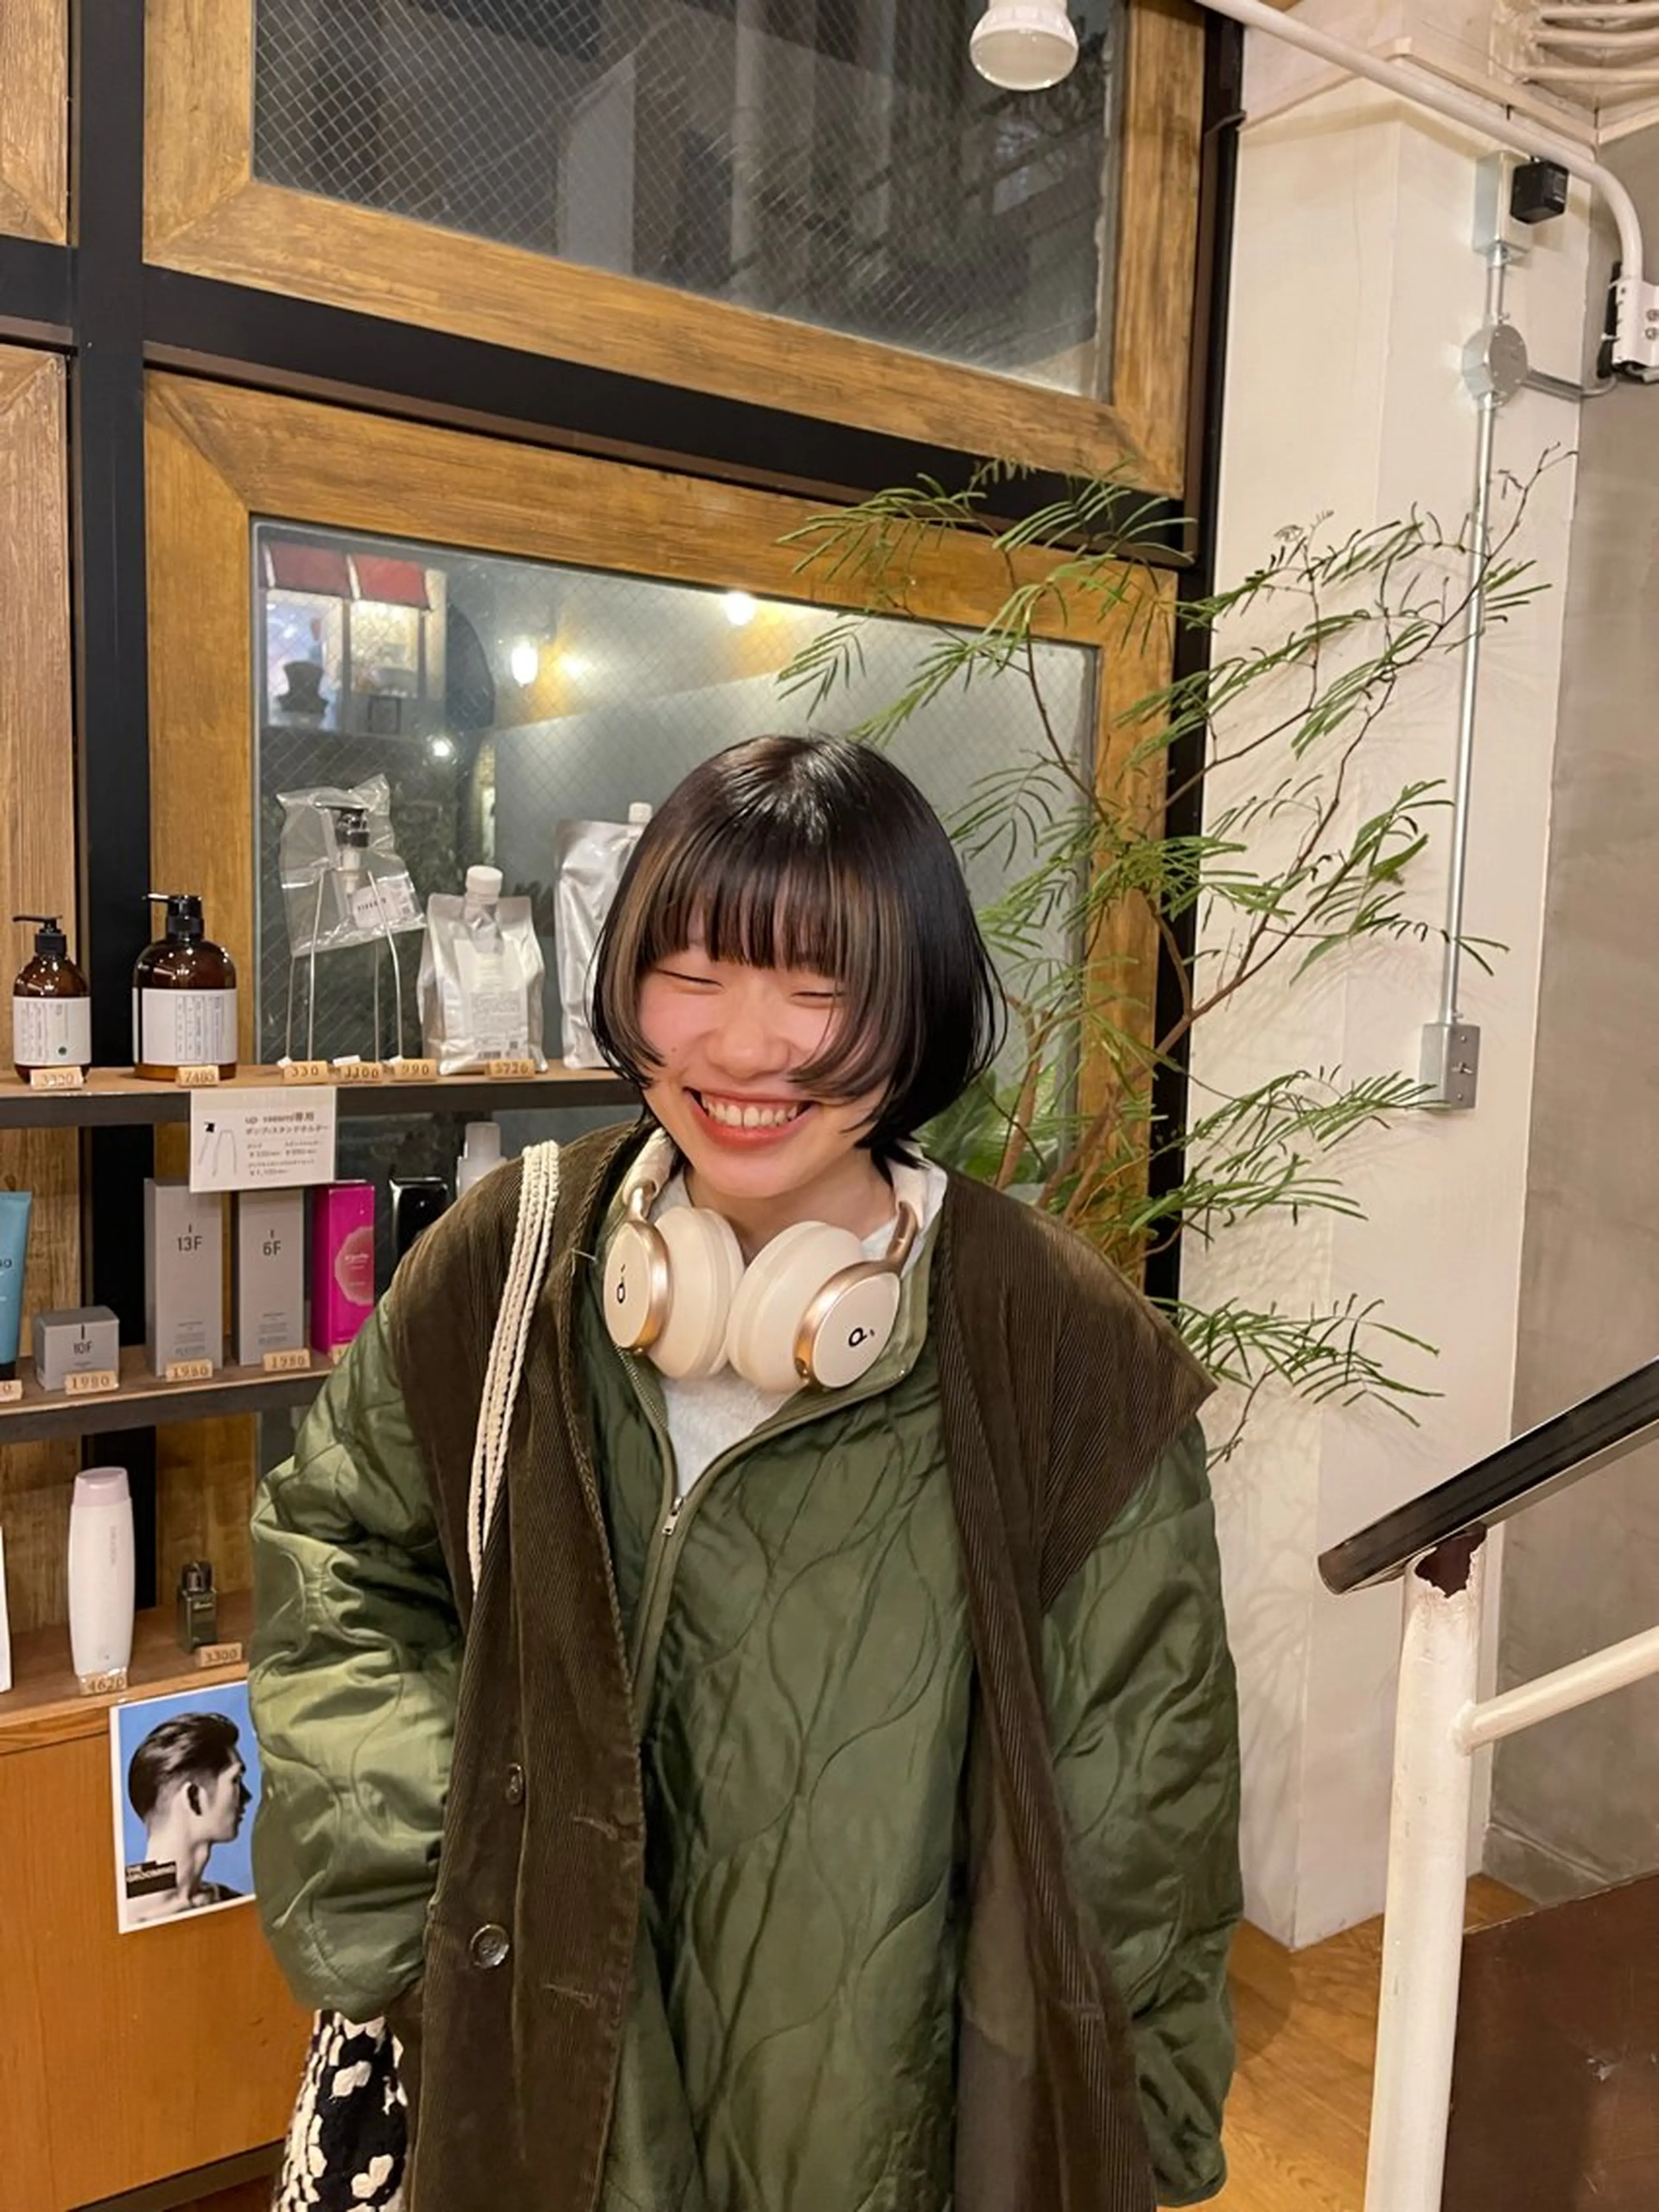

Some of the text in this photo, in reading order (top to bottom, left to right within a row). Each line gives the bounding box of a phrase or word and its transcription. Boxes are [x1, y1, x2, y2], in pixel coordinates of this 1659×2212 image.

[292, 1065, 319, 1077] 330
[346, 1067, 379, 1079] 1100
[401, 1063, 429, 1076] 990
[177, 1235, 203, 1252] 13F
[262, 1239, 281, 1256] 6F
[73, 1340, 93, 1355] 10F
[272, 1356, 305, 1369] 1980
[72, 1375, 109, 1389] 1980
